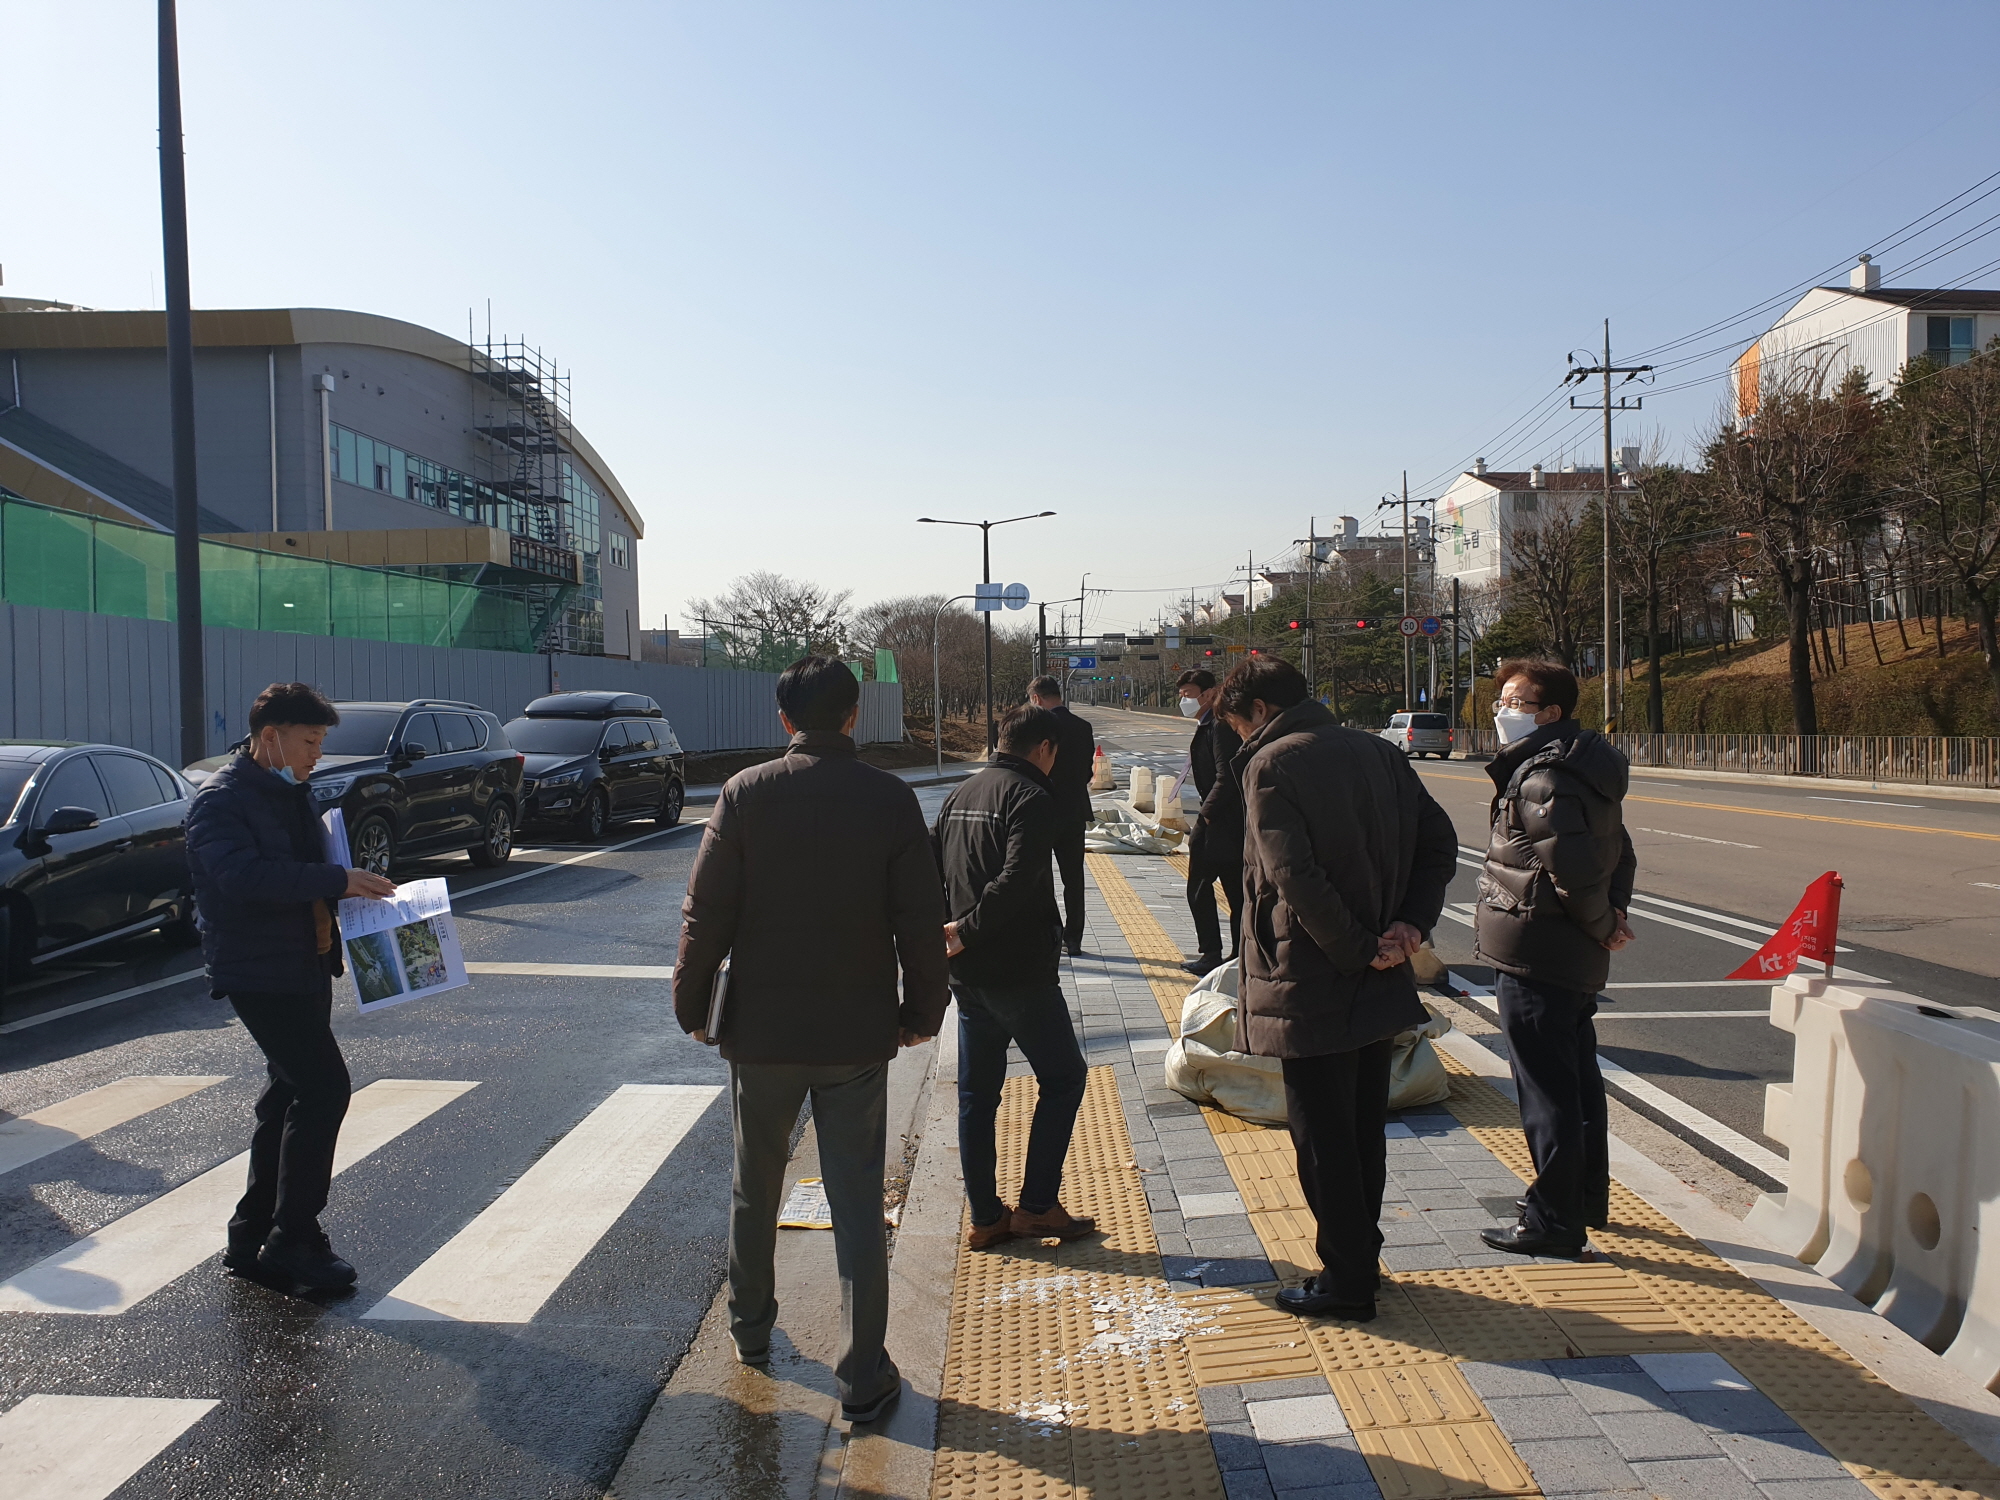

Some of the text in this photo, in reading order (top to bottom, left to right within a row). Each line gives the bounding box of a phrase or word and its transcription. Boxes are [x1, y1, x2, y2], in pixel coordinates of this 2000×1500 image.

[1458, 552, 1470, 570] 511
[1404, 621, 1414, 630] 50
[1758, 952, 1783, 973] kt
